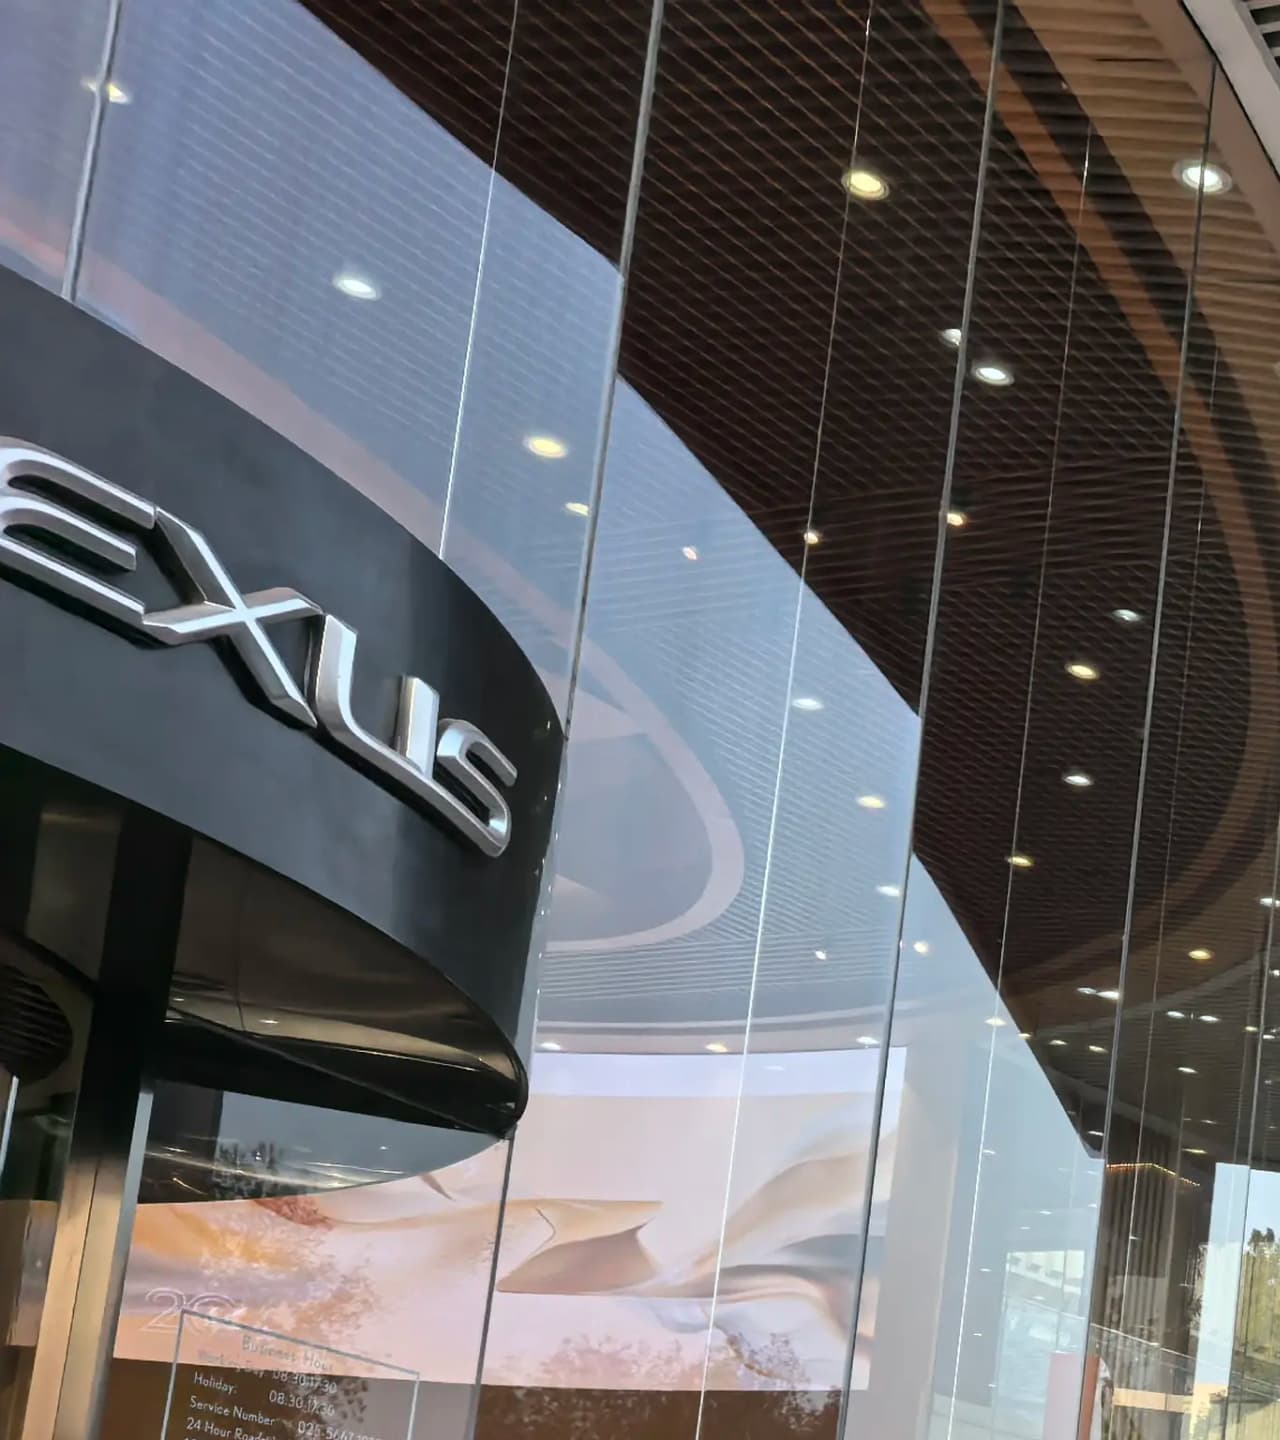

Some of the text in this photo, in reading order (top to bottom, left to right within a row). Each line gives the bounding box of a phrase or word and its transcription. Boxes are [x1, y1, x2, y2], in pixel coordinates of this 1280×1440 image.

[189, 1395, 230, 1416] Service
[186, 1416, 201, 1432] 24
[204, 1420, 232, 1438] Hour
